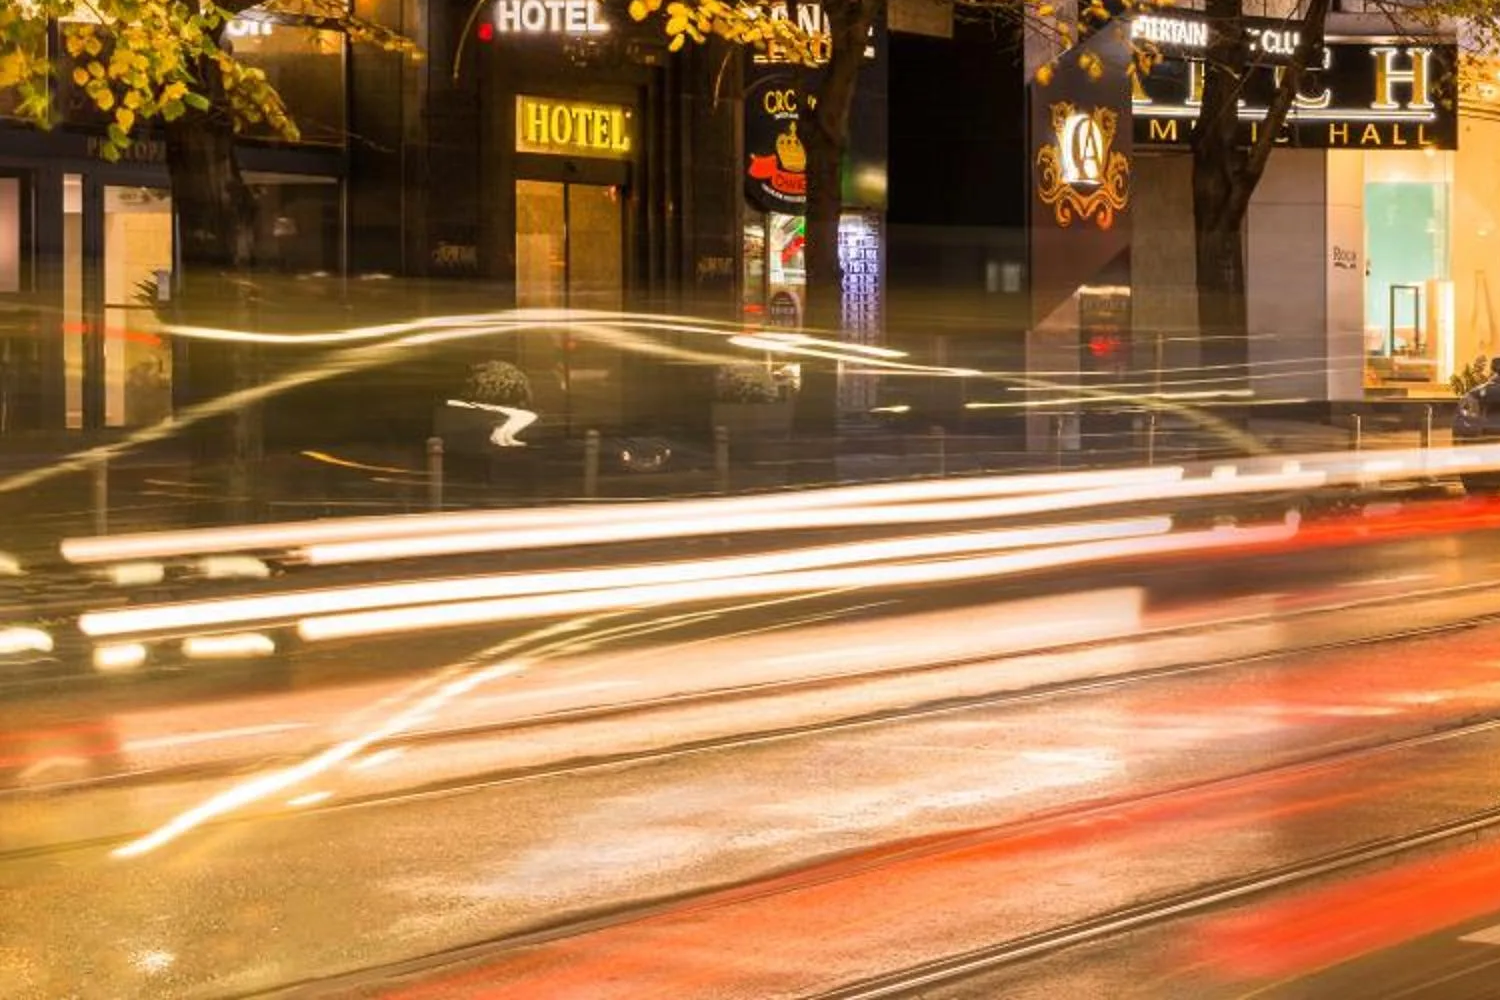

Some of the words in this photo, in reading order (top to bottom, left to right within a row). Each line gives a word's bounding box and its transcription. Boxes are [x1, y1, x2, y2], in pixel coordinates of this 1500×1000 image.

[1261, 29, 1299, 54] CLU
[525, 102, 631, 151] HOTEL
[1328, 122, 1432, 145] HALL
